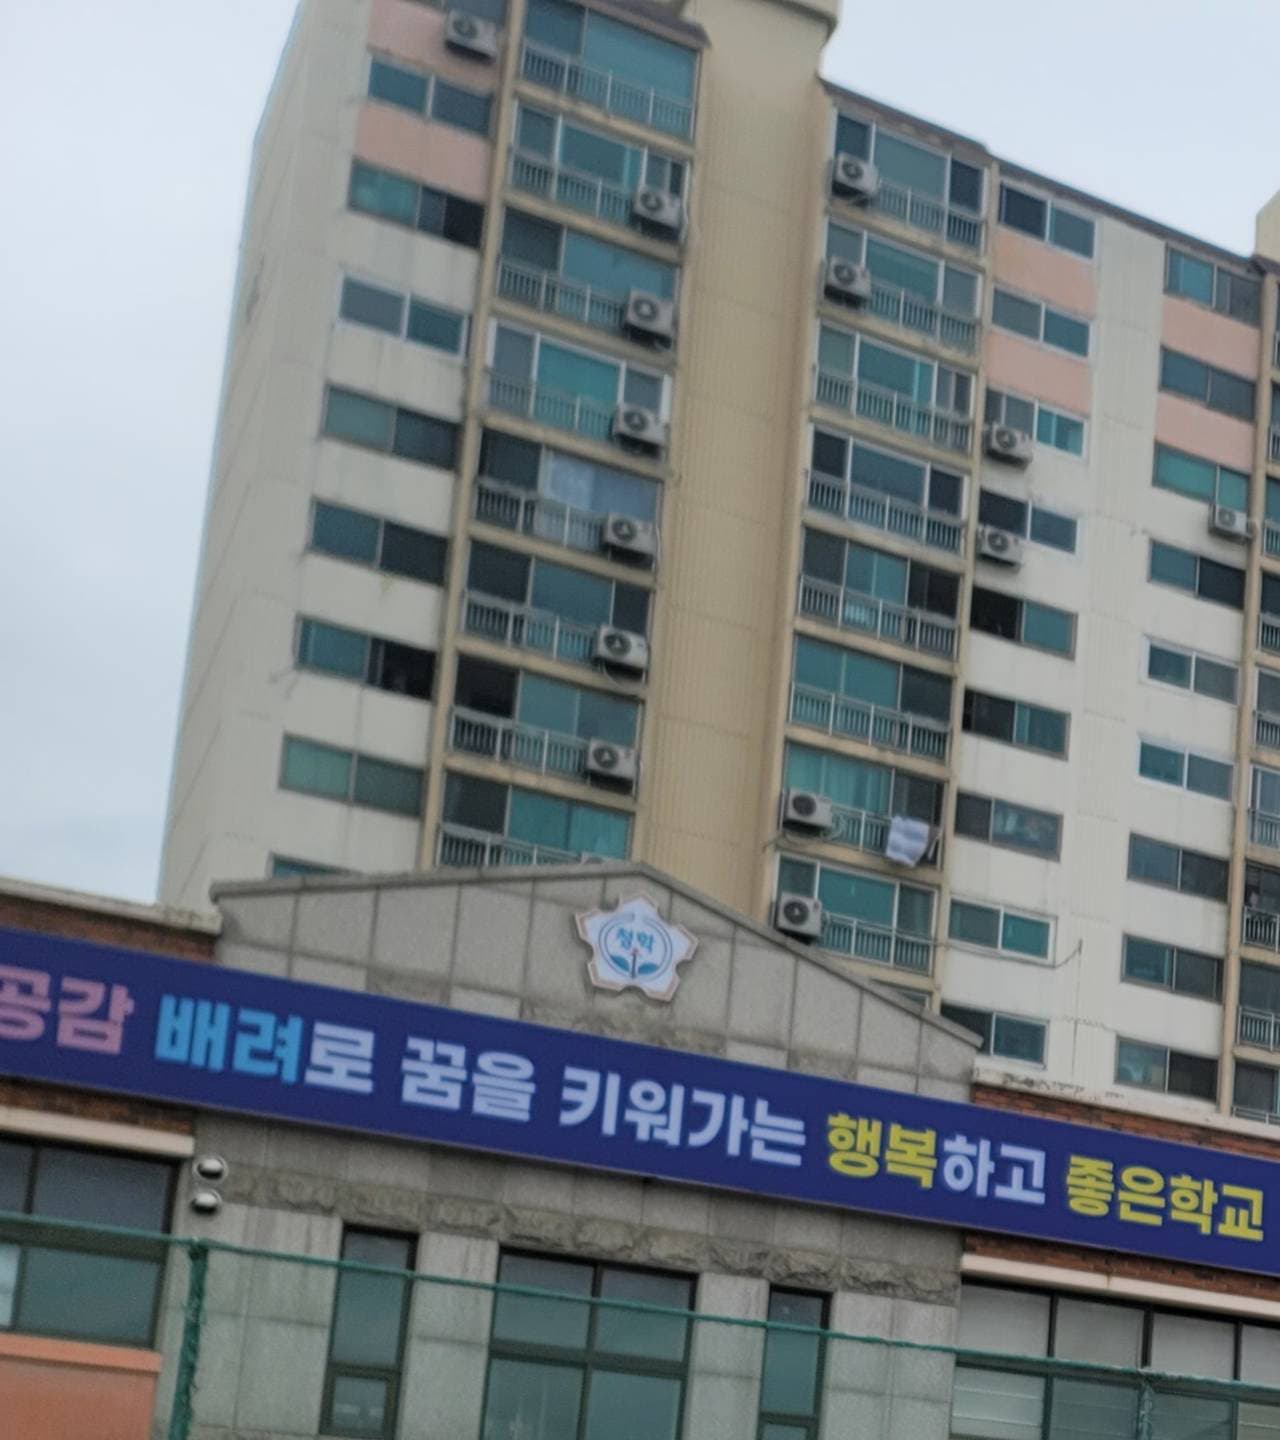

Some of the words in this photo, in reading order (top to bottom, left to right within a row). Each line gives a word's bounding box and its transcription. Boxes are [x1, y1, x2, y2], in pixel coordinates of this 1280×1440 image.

[0, 962, 135, 1056] 공감
[154, 993, 376, 1094] 배려로
[400, 1035, 537, 1123] 꿈을
[558, 1064, 807, 1168] 키워가는
[827, 1112, 1047, 1206] 행복하고
[1065, 1153, 1265, 1243] 좋은학교
